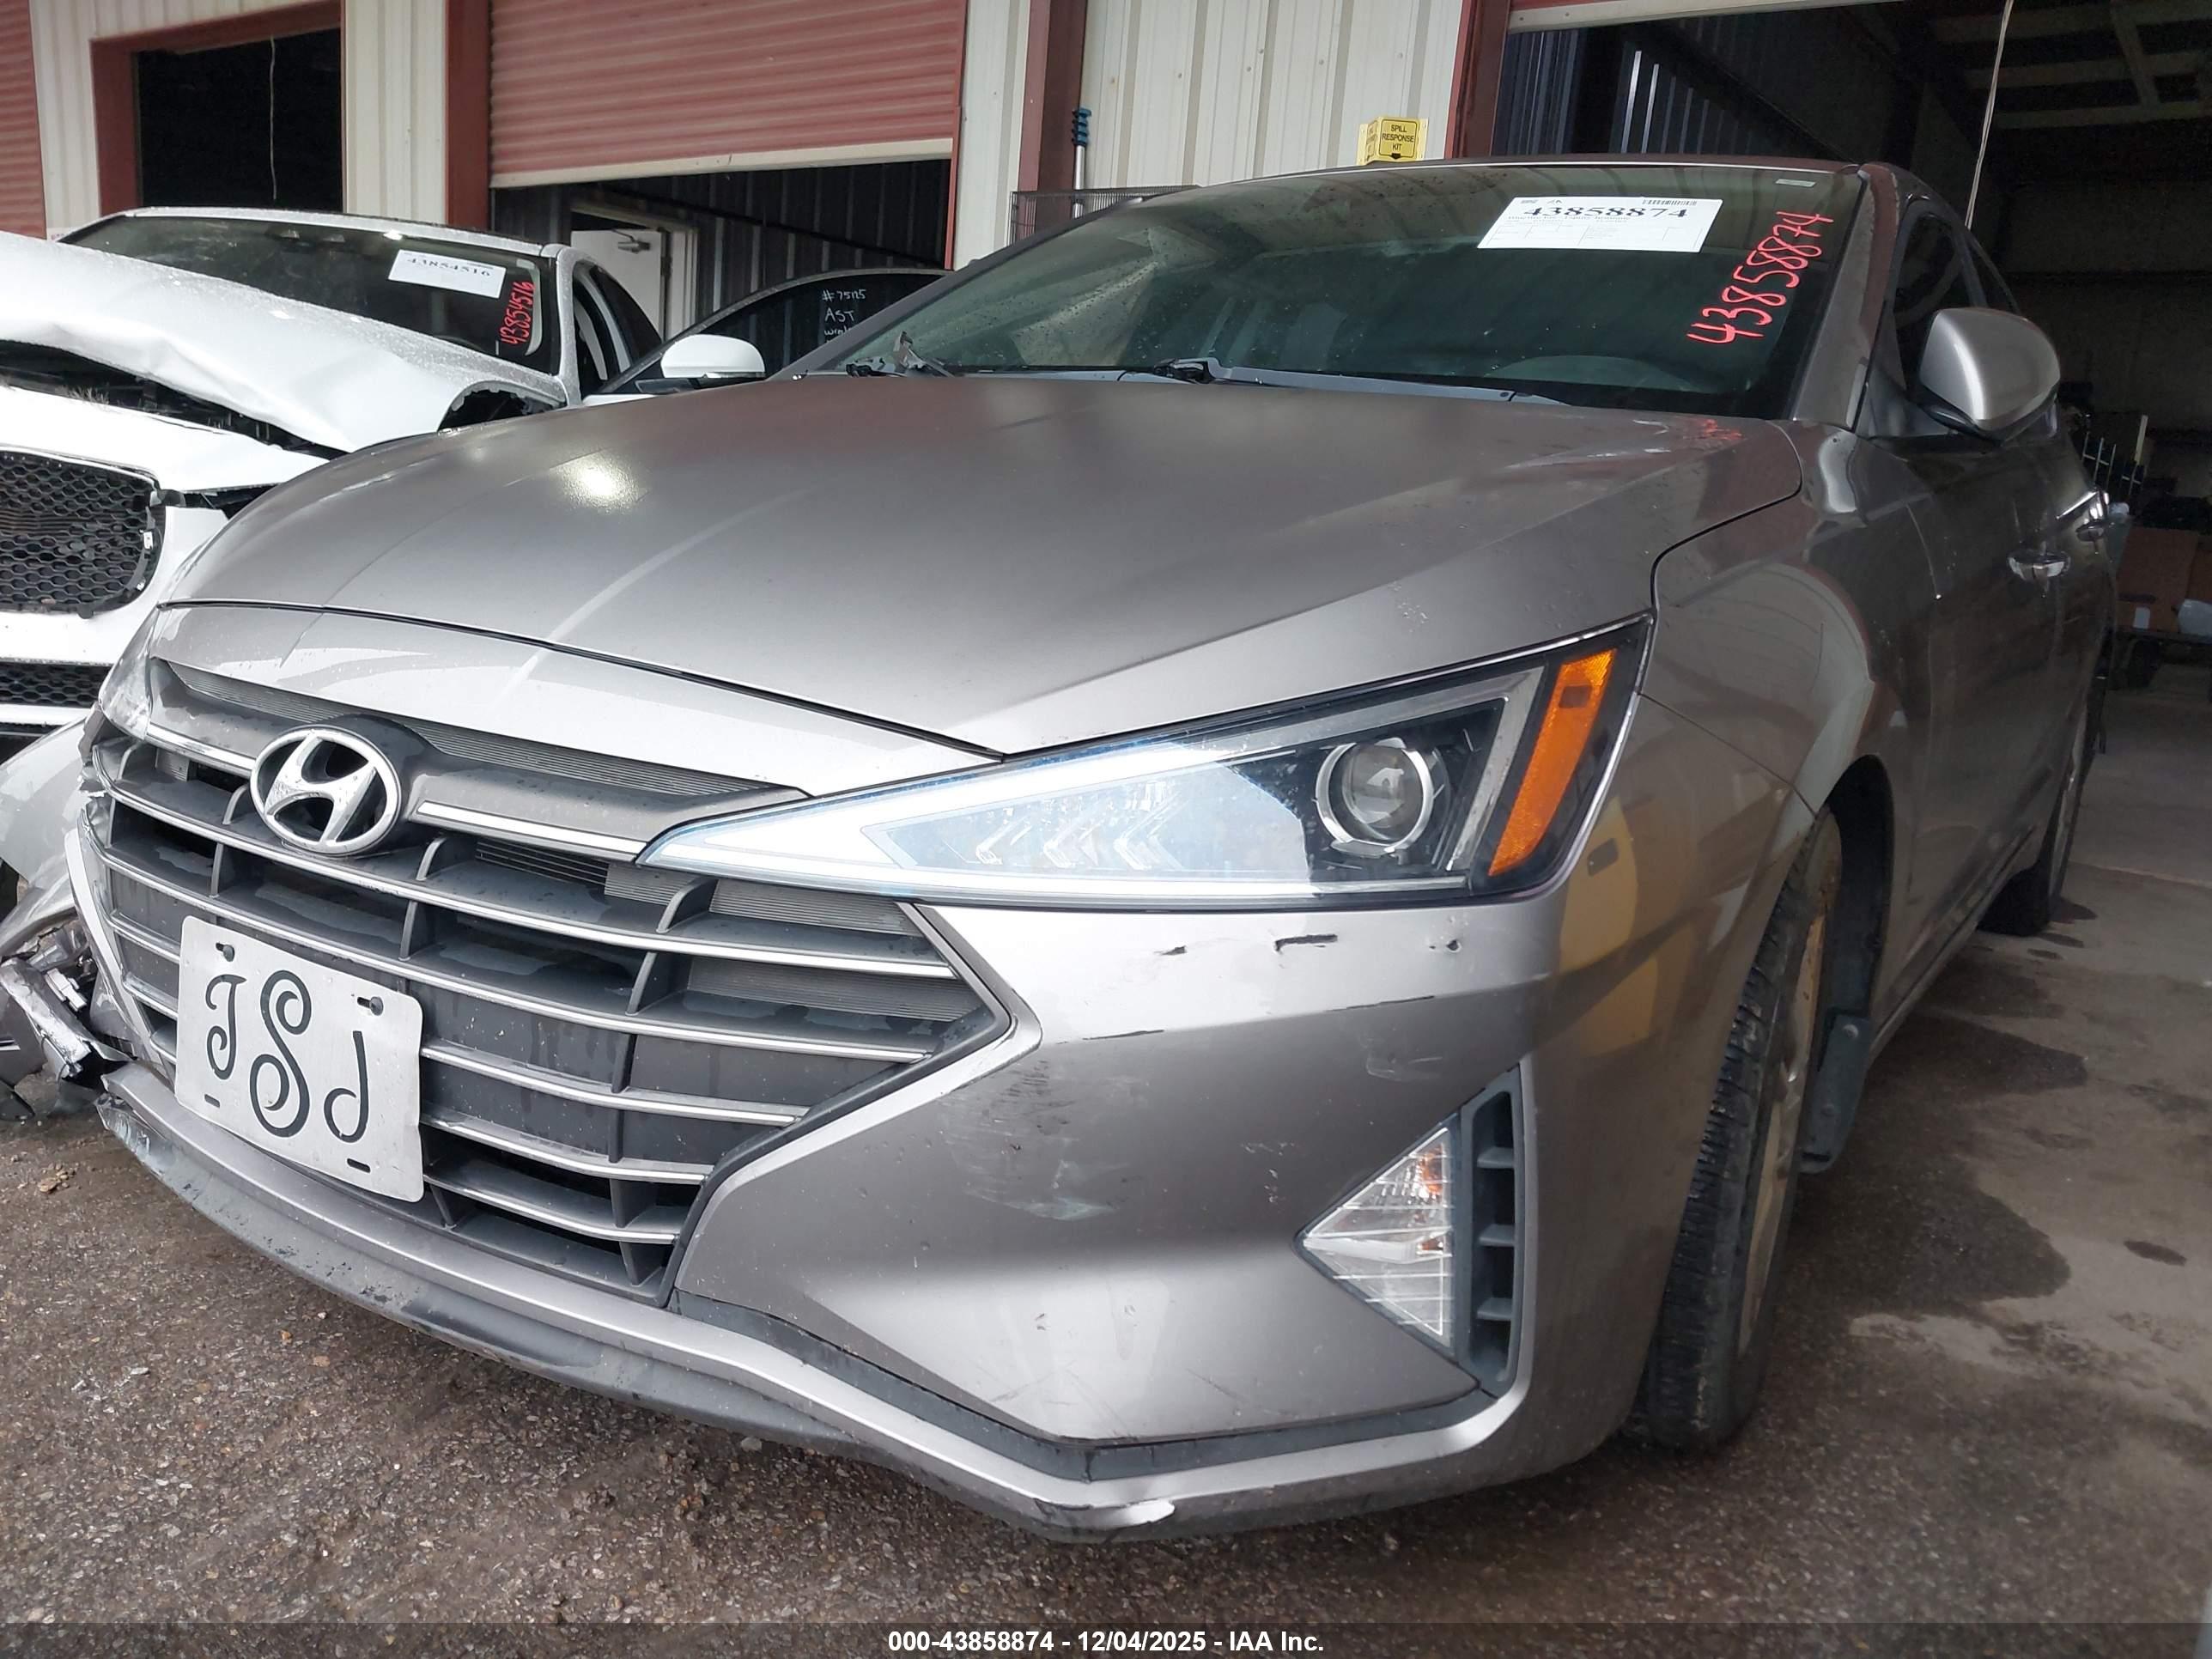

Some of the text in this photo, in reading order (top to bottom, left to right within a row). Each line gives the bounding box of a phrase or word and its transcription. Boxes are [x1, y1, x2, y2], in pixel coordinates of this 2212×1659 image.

[1390, 125, 1407, 133] SPILL
[1382, 133, 1415, 143] RESPONSE
[1523, 206, 1688, 218] 43858874
[1686, 210, 1834, 343] 43858874
[500, 281, 536, 344] 43854516
